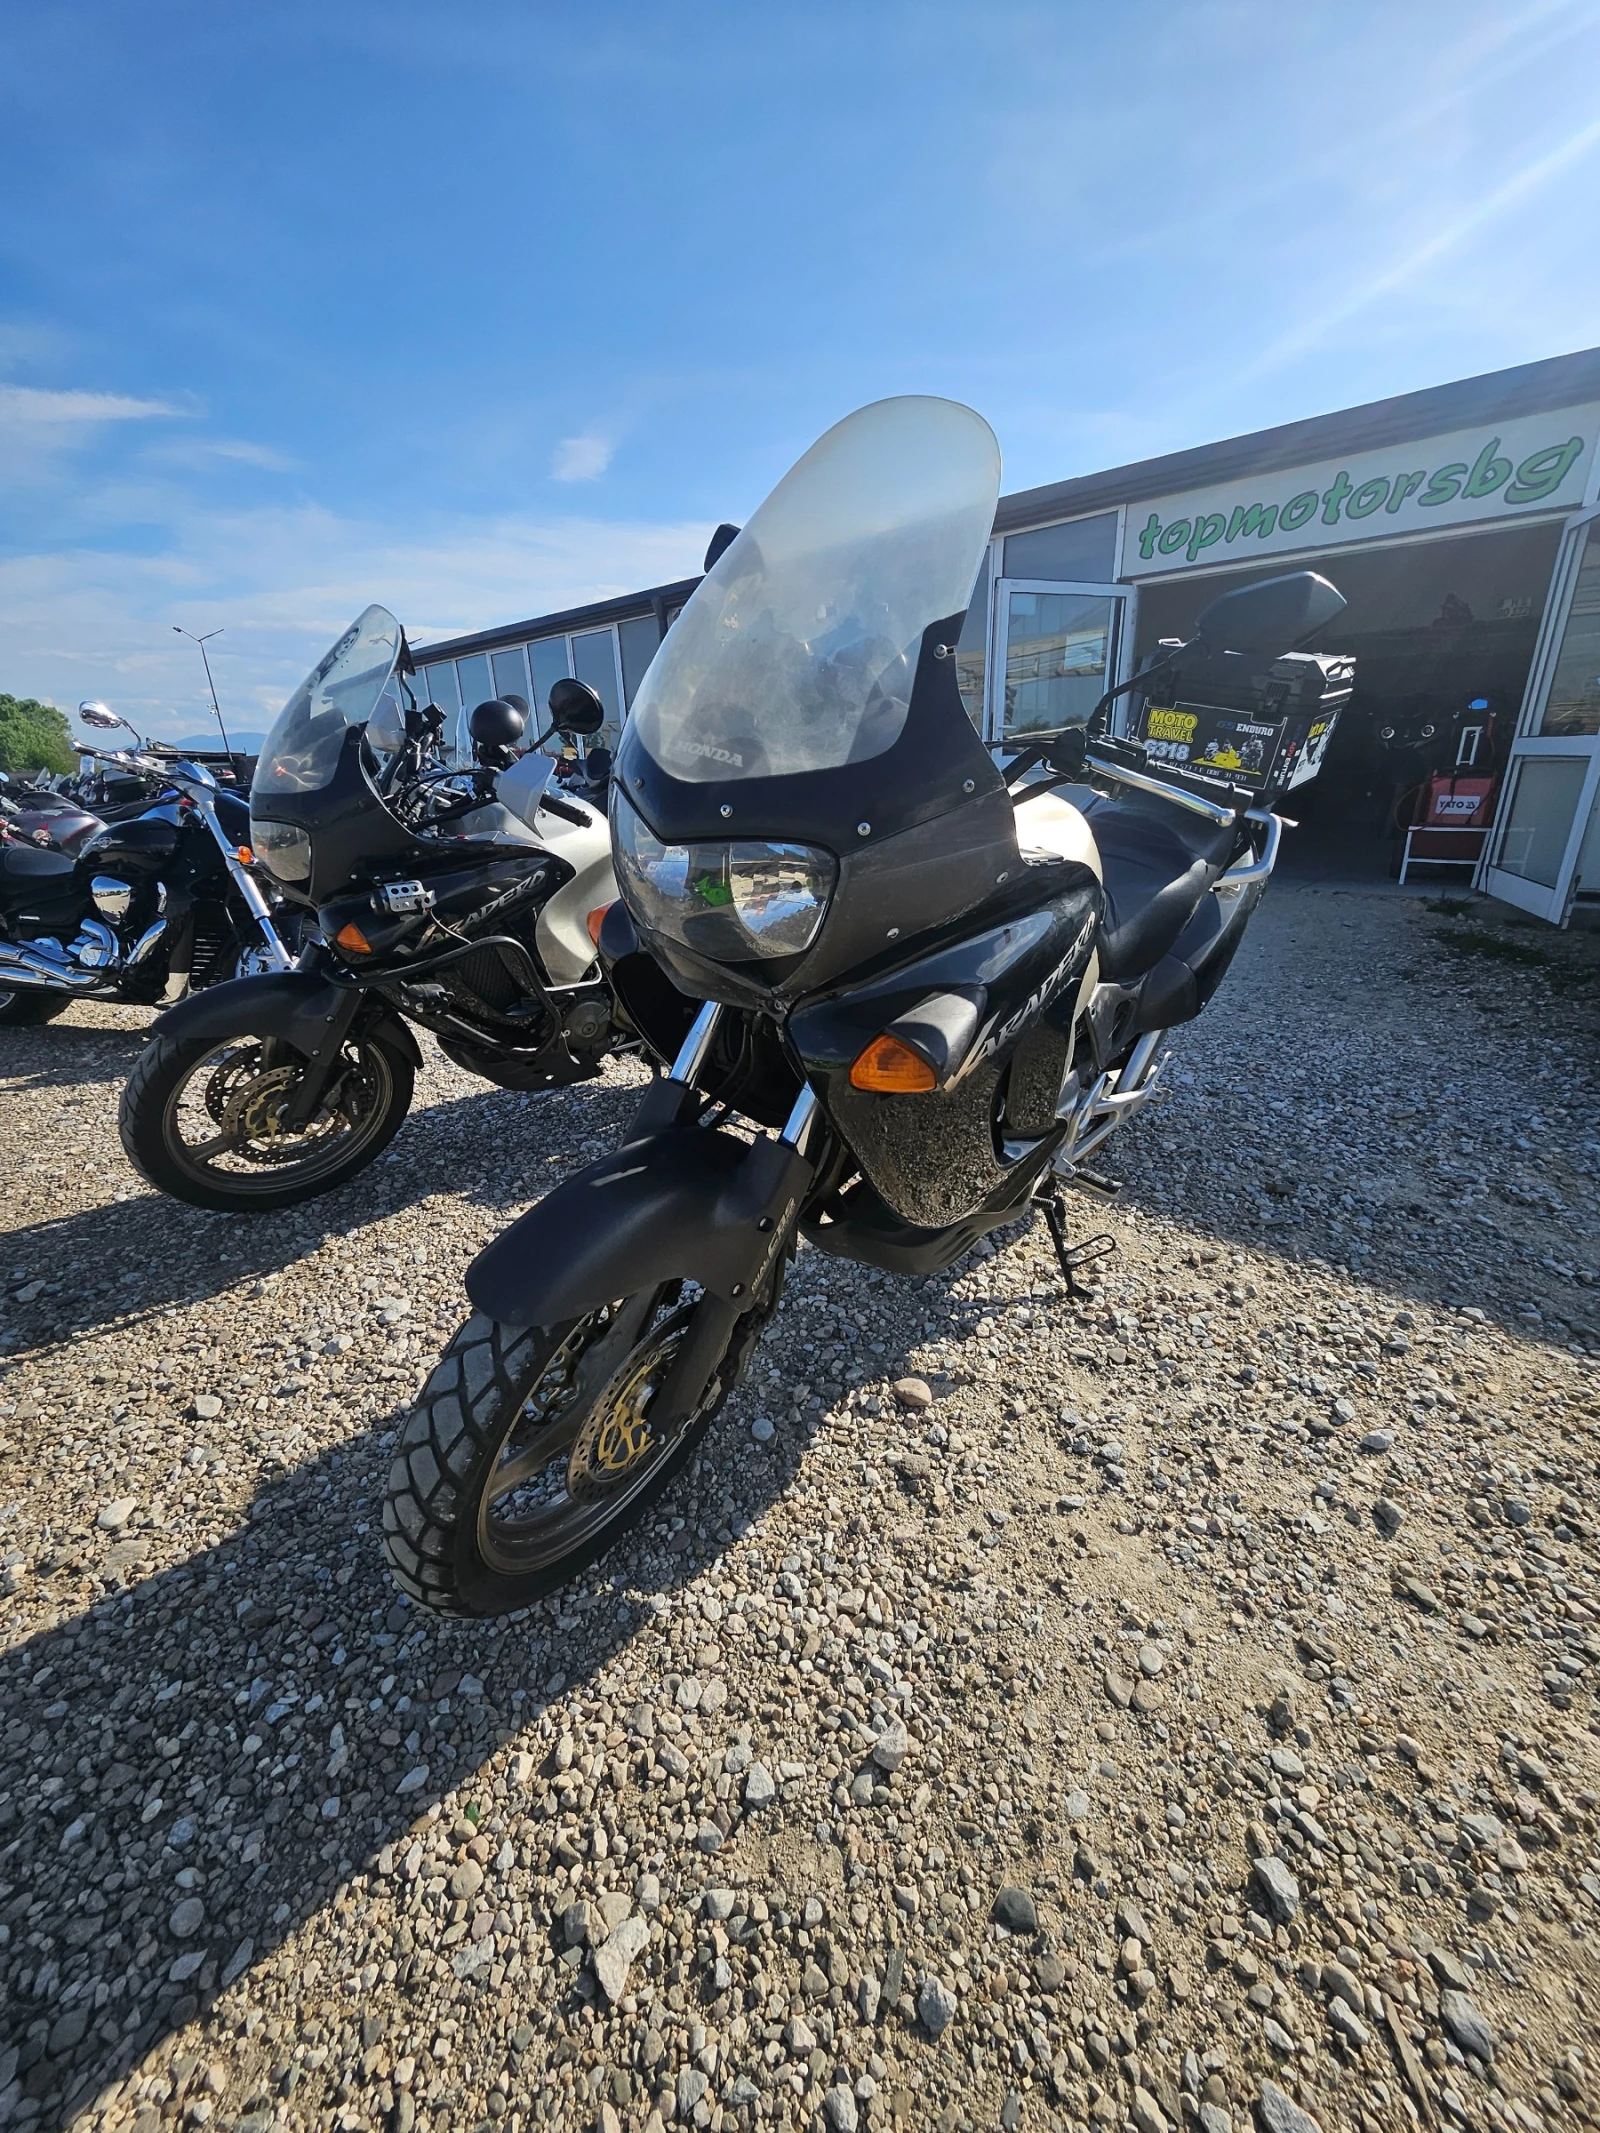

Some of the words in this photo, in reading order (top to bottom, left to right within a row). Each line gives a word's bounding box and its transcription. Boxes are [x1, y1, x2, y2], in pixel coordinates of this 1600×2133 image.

[1139, 437, 1584, 561] topmotorsbg
[1150, 710, 1197, 729] MOTO
[1236, 723, 1274, 736] ENDURO
[1148, 725, 1193, 743] TRAVEL
[678, 740, 743, 767] HONDA
[1143, 738, 1190, 761] G318
